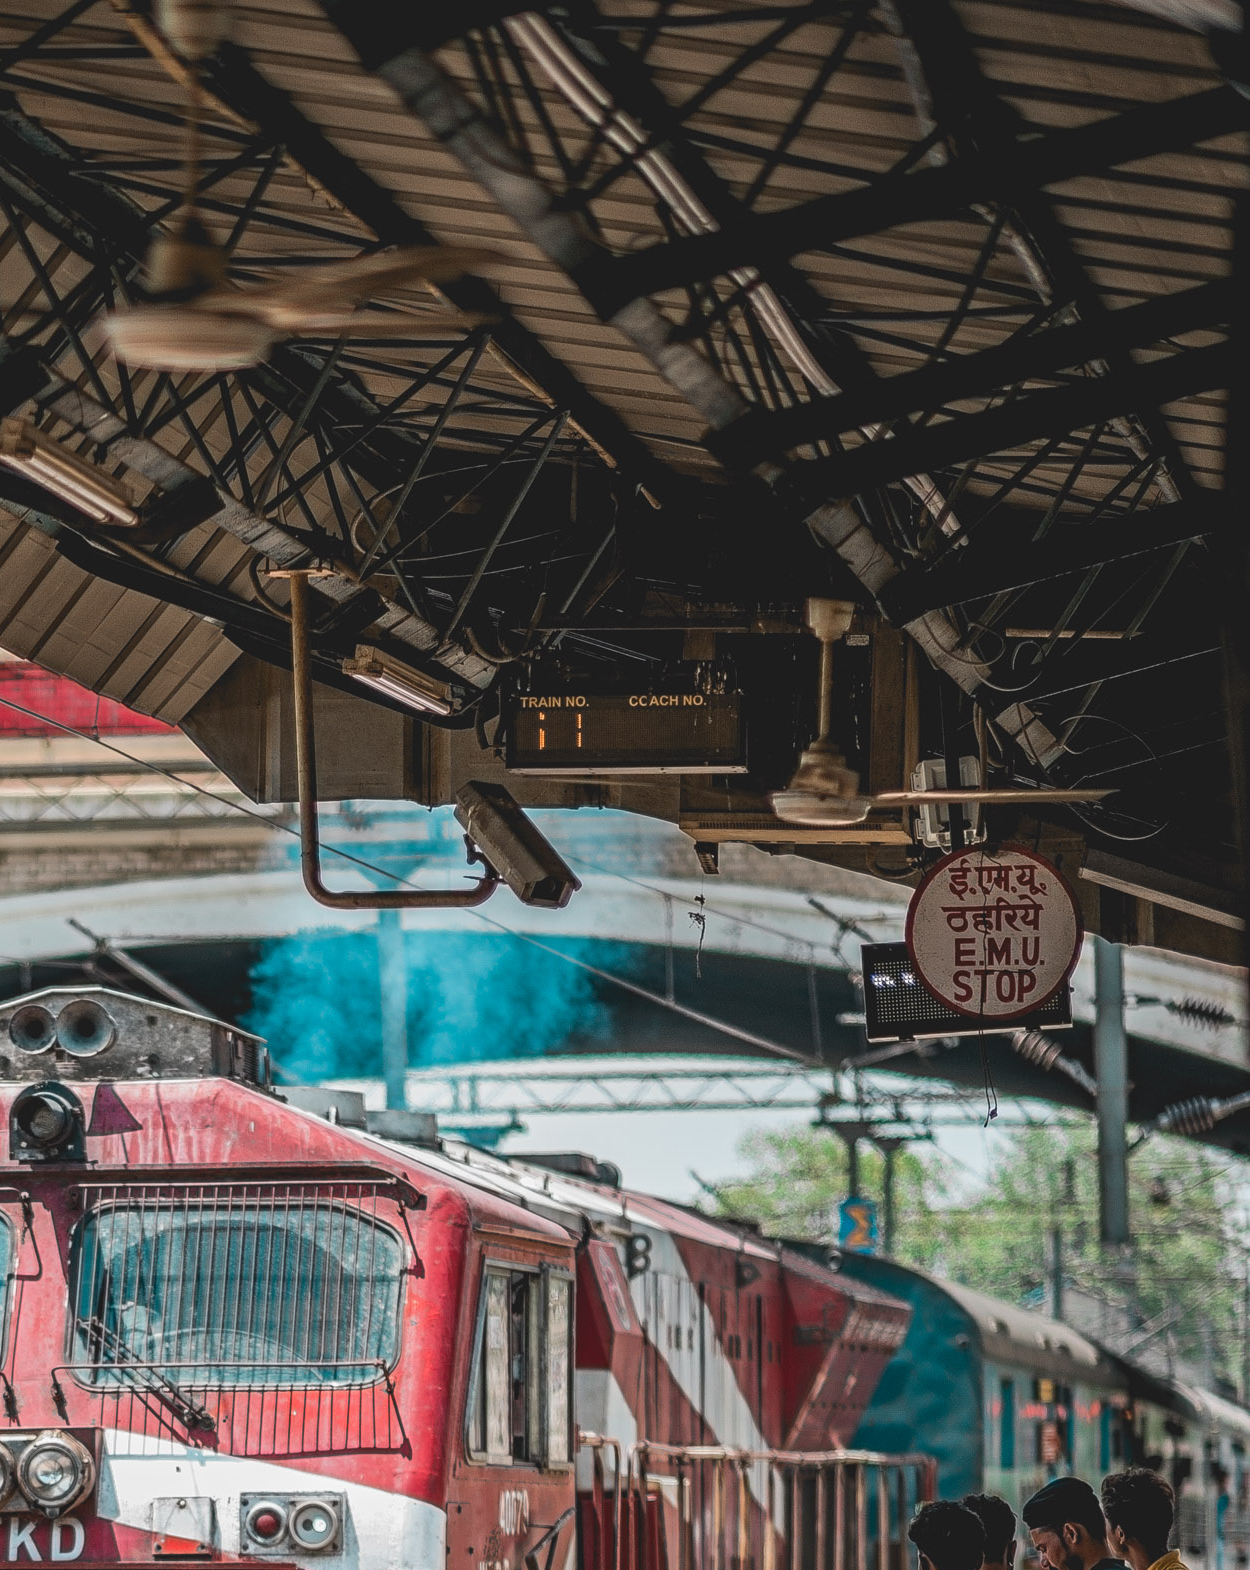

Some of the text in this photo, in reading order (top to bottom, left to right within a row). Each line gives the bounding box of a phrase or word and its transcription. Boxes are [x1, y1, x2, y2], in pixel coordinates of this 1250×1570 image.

[520, 696, 589, 708] TRAIN NO.
[683, 695, 707, 706] NO.
[941, 895, 1044, 933] ठहरिये
[954, 936, 1045, 967] E.M.U.
[952, 969, 1037, 1003] STOP
